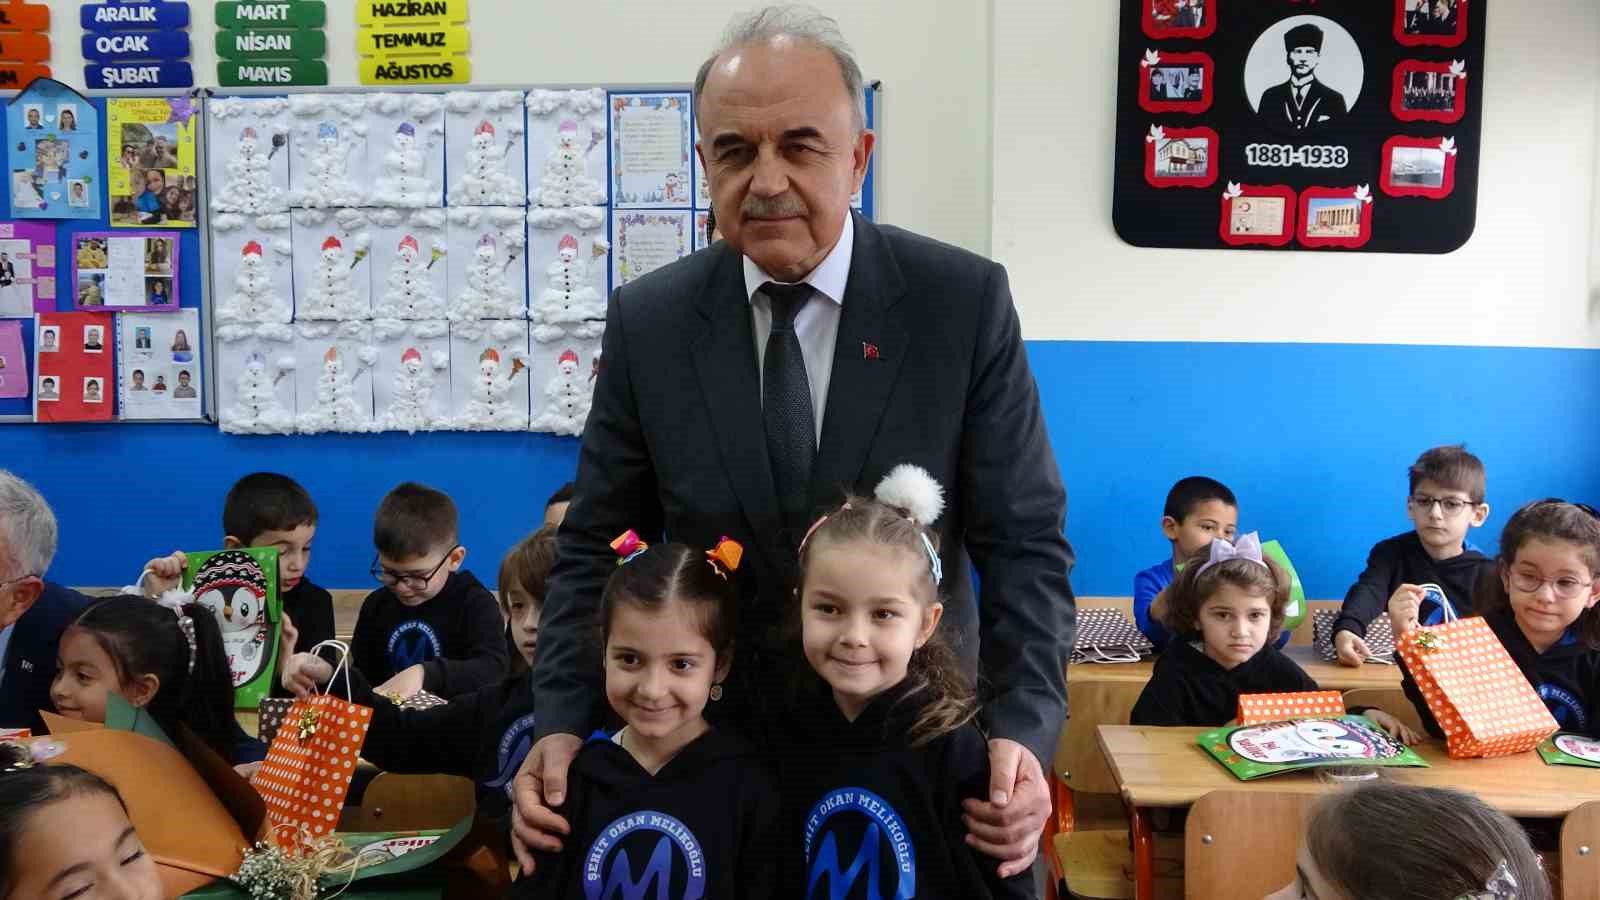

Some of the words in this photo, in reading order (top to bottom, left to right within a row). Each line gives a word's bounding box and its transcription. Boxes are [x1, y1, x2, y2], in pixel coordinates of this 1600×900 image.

[95, 6, 157, 22] ARALIK
[236, 4, 291, 20] MART
[372, 0, 447, 17] HAZİRAN
[96, 35, 149, 53] OCAK
[235, 31, 291, 51] NİSAN
[371, 32, 447, 49] TEMMUZ
[101, 67, 160, 87] ŞUBAT
[238, 66, 292, 82] MAYIS
[375, 61, 454, 80] AĞUSTOS
[1245, 143, 1348, 168] 1881-1938
[819, 792, 854, 816] OKAN
[587, 837, 609, 882] ŞEHİT
[608, 815, 645, 838] OKAN
